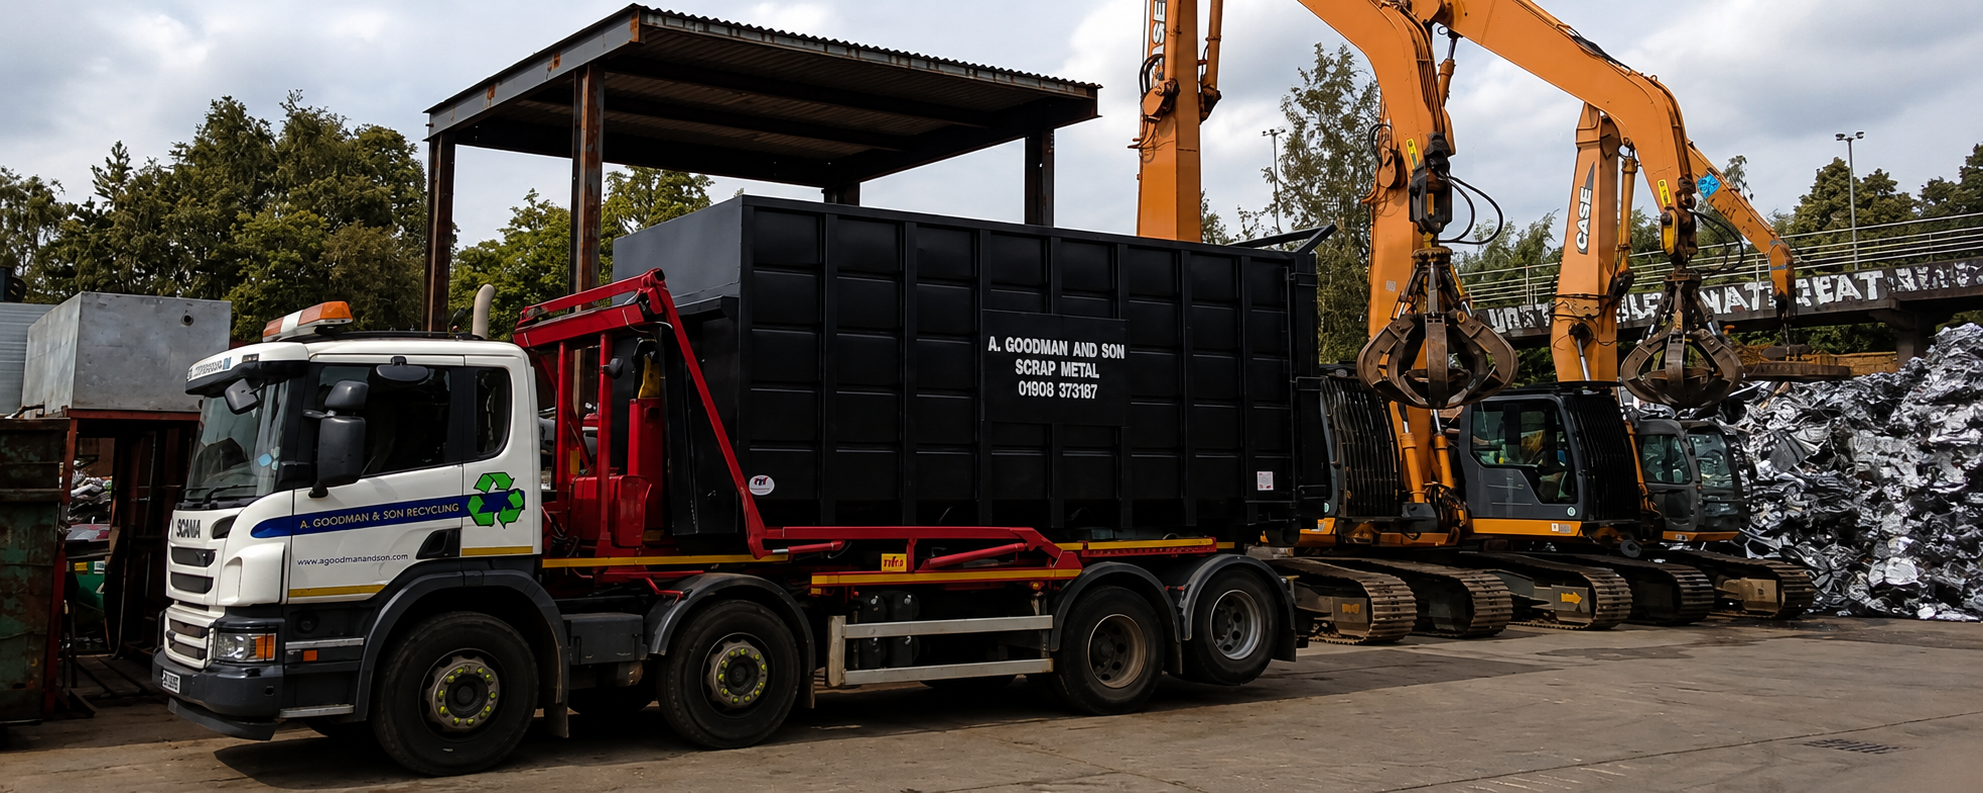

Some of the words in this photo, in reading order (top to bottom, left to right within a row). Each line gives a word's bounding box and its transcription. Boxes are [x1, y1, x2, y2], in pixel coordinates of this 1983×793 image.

[1576, 185, 1593, 251] CASE
[988, 336, 1001, 352] A.
[1005, 336, 1068, 356] GOODMAN
[1072, 341, 1098, 358] AND
[1101, 343, 1125, 359] SON
[1015, 358, 1056, 376] SCRAP
[1060, 361, 1100, 379] METAL
[1018, 380, 1054, 397] 01908
[1059, 382, 1098, 399] 373187
[300, 519, 310, 529] A.
[313, 513, 369, 528] GOODMAN
[372, 511, 380, 521] &
[383, 507, 404, 520] SON
[406, 503, 460, 517] RECYCLING
[296, 553, 409, 567] www.agoodmanandson.com
